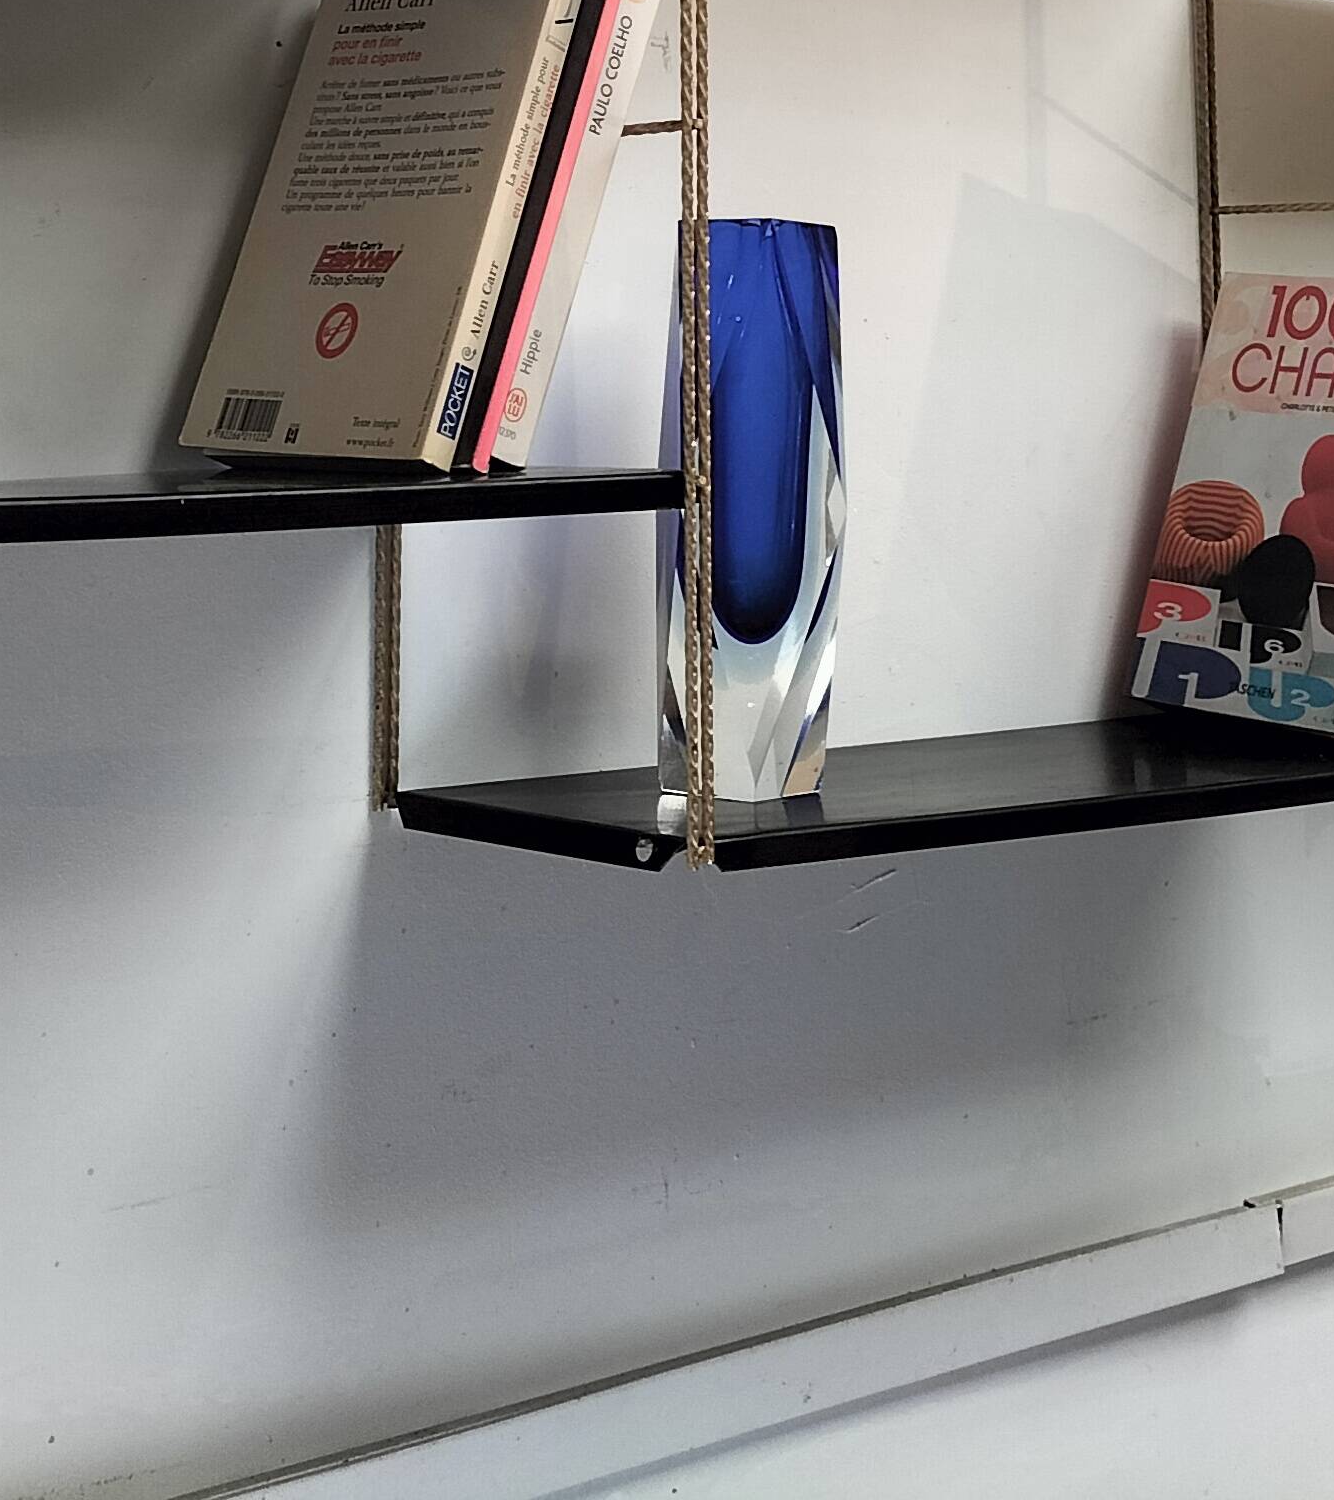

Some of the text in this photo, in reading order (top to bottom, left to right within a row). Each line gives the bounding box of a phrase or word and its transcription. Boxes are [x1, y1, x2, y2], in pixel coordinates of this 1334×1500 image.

[337, 19, 426, 35] La méthode simple
[331, 35, 404, 53] pour en finir
[327, 50, 423, 67] avec la cigarette
[589, 15, 633, 136] PAULO COELHO
[539, 63, 560, 119] cigarette
[505, 171, 517, 188] La
[525, 85, 541, 121] simple
[536, 56, 550, 85] pour
[533, 121, 545, 136] la
[527, 138, 540, 168] avec
[511, 203, 524, 220] en
[338, 241, 359, 250] Allen
[308, 273, 385, 288] To Stop Smoking
[469, 260, 500, 340] Allen Carr
[519, 329, 543, 375] Hippie
[440, 364, 471, 438] POCKET
[1153, 602, 1183, 622] 3
[1264, 639, 1284, 654] 6
[1290, 689, 1311, 706] 2
